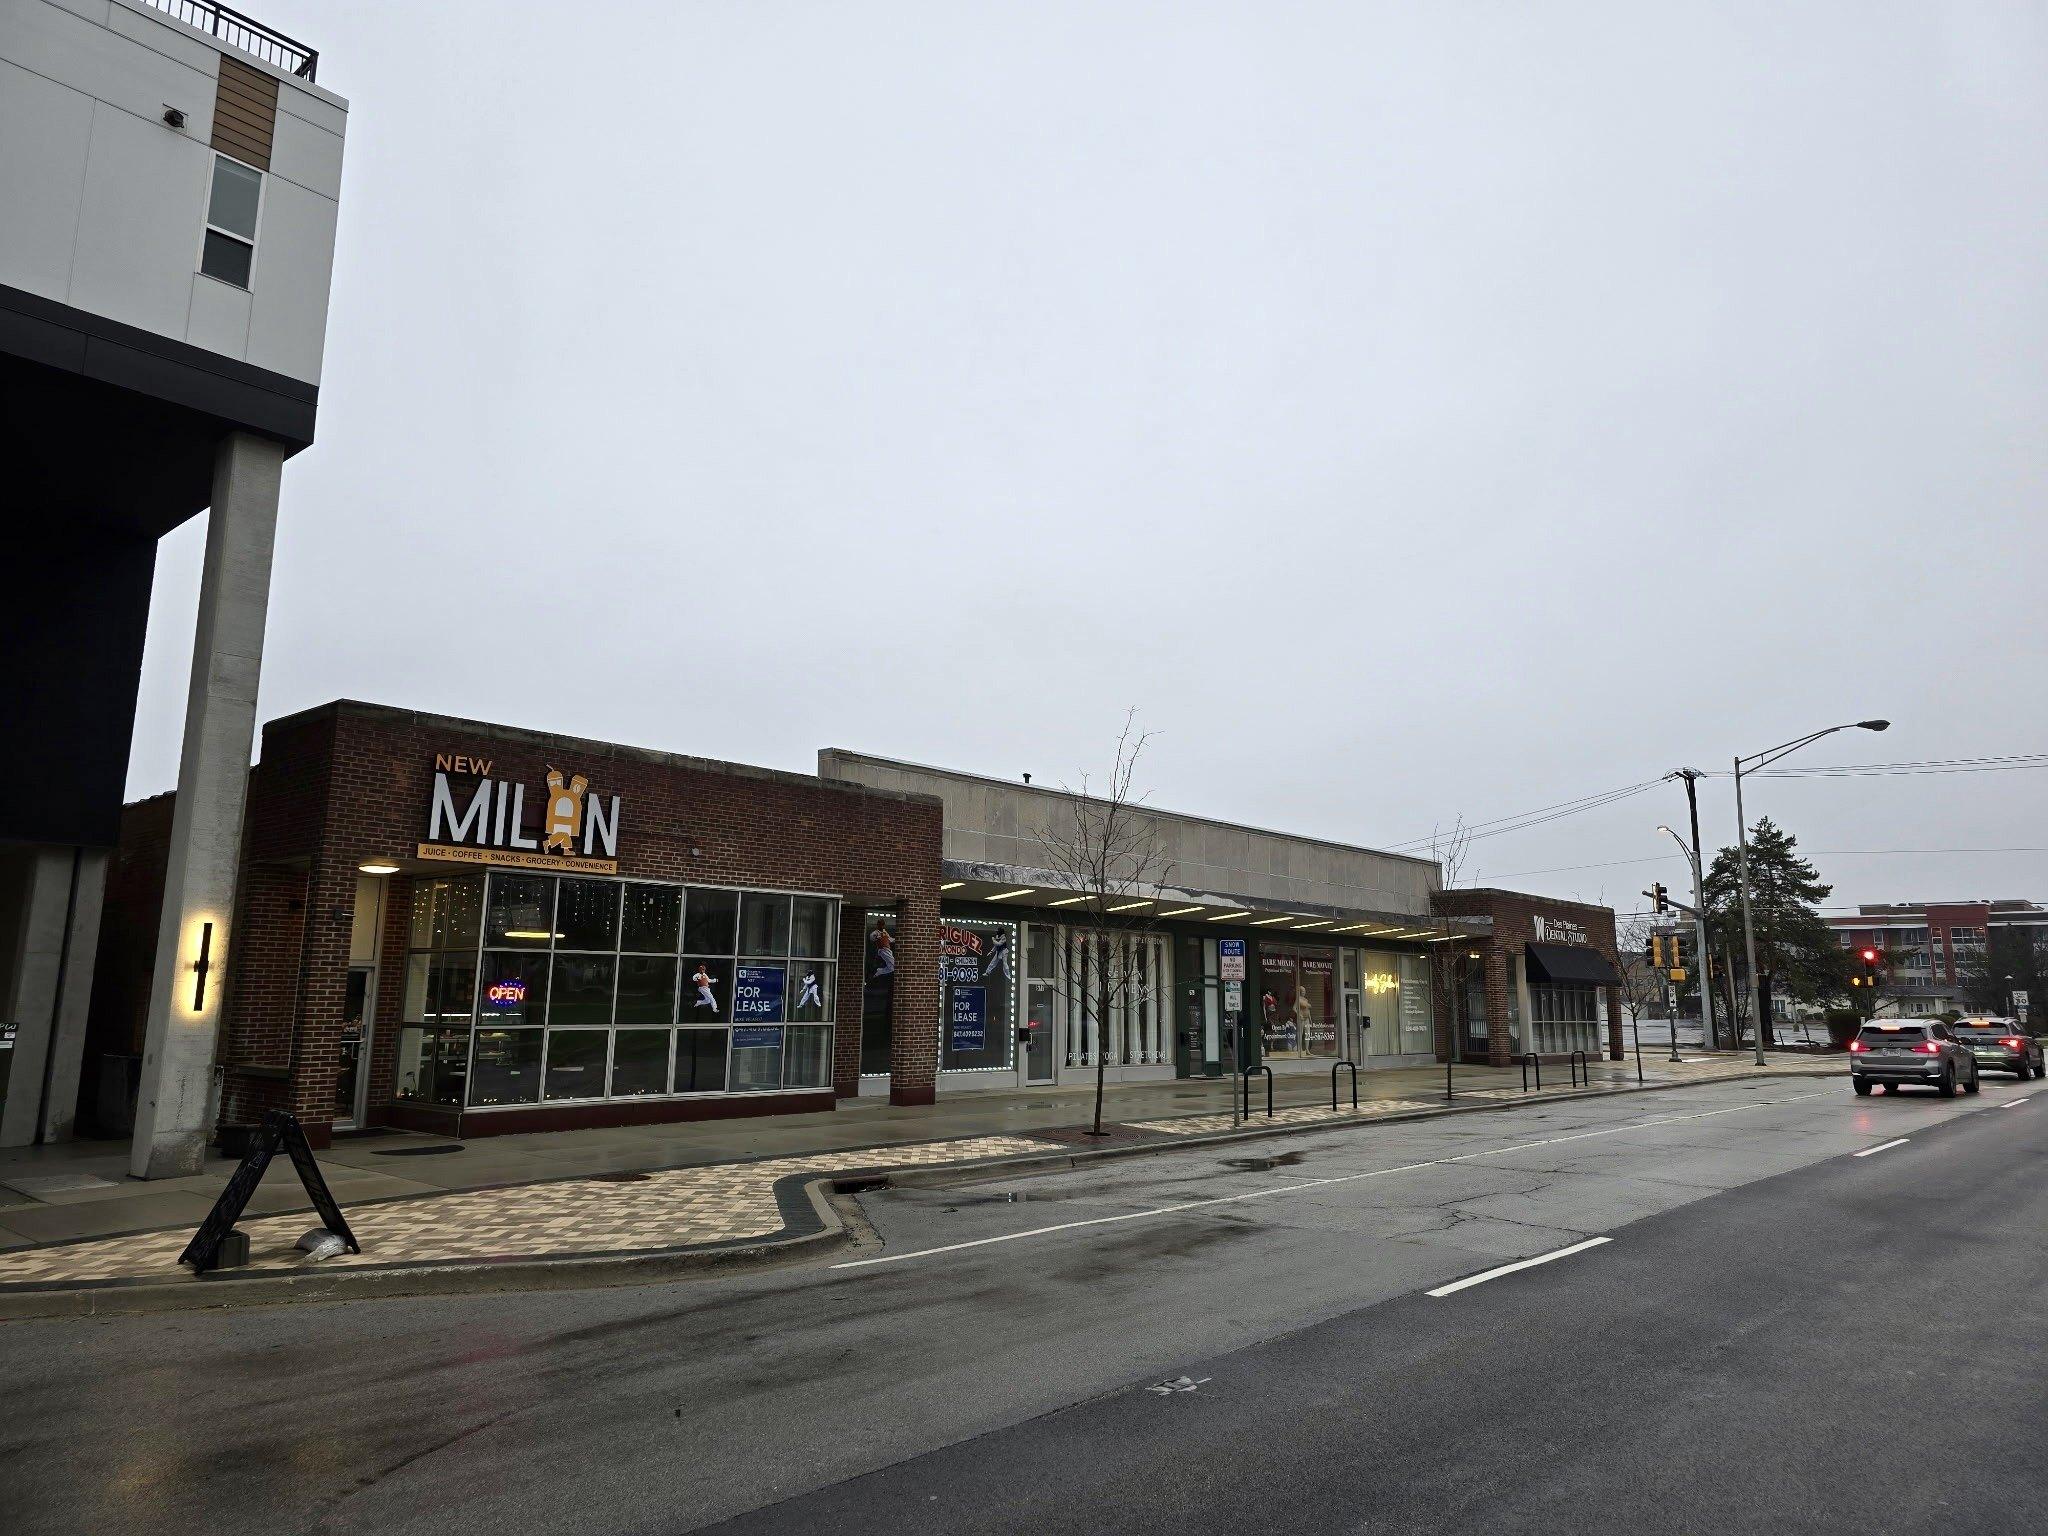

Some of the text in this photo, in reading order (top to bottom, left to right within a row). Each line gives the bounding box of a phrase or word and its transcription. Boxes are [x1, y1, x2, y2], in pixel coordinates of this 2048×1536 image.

[435, 753, 493, 776] NEW
[428, 772, 621, 857] MILAN
[422, 846, 613, 871] JUICE COFFEE SNACKS GROCERY CONVENIENCE
[940, 925, 982, 956] RIGUEZ
[1545, 925, 1588, 947] DENTAL STUDIO
[1224, 941, 1240, 949] SNOW
[1262, 958, 1277, 967] BARE
[1302, 960, 1318, 969] BARE
[939, 966, 979, 982] 81-9095
[489, 986, 525, 1001] OPEN
[737, 986, 760, 998] FOR
[735, 1000, 771, 1012] LEASE
[954, 1001, 970, 1011] FOR
[954, 1012, 978, 1022] LEASE
[1068, 1052, 1097, 1061] PILATES
[1129, 1050, 1167, 1059] STRETCHING
